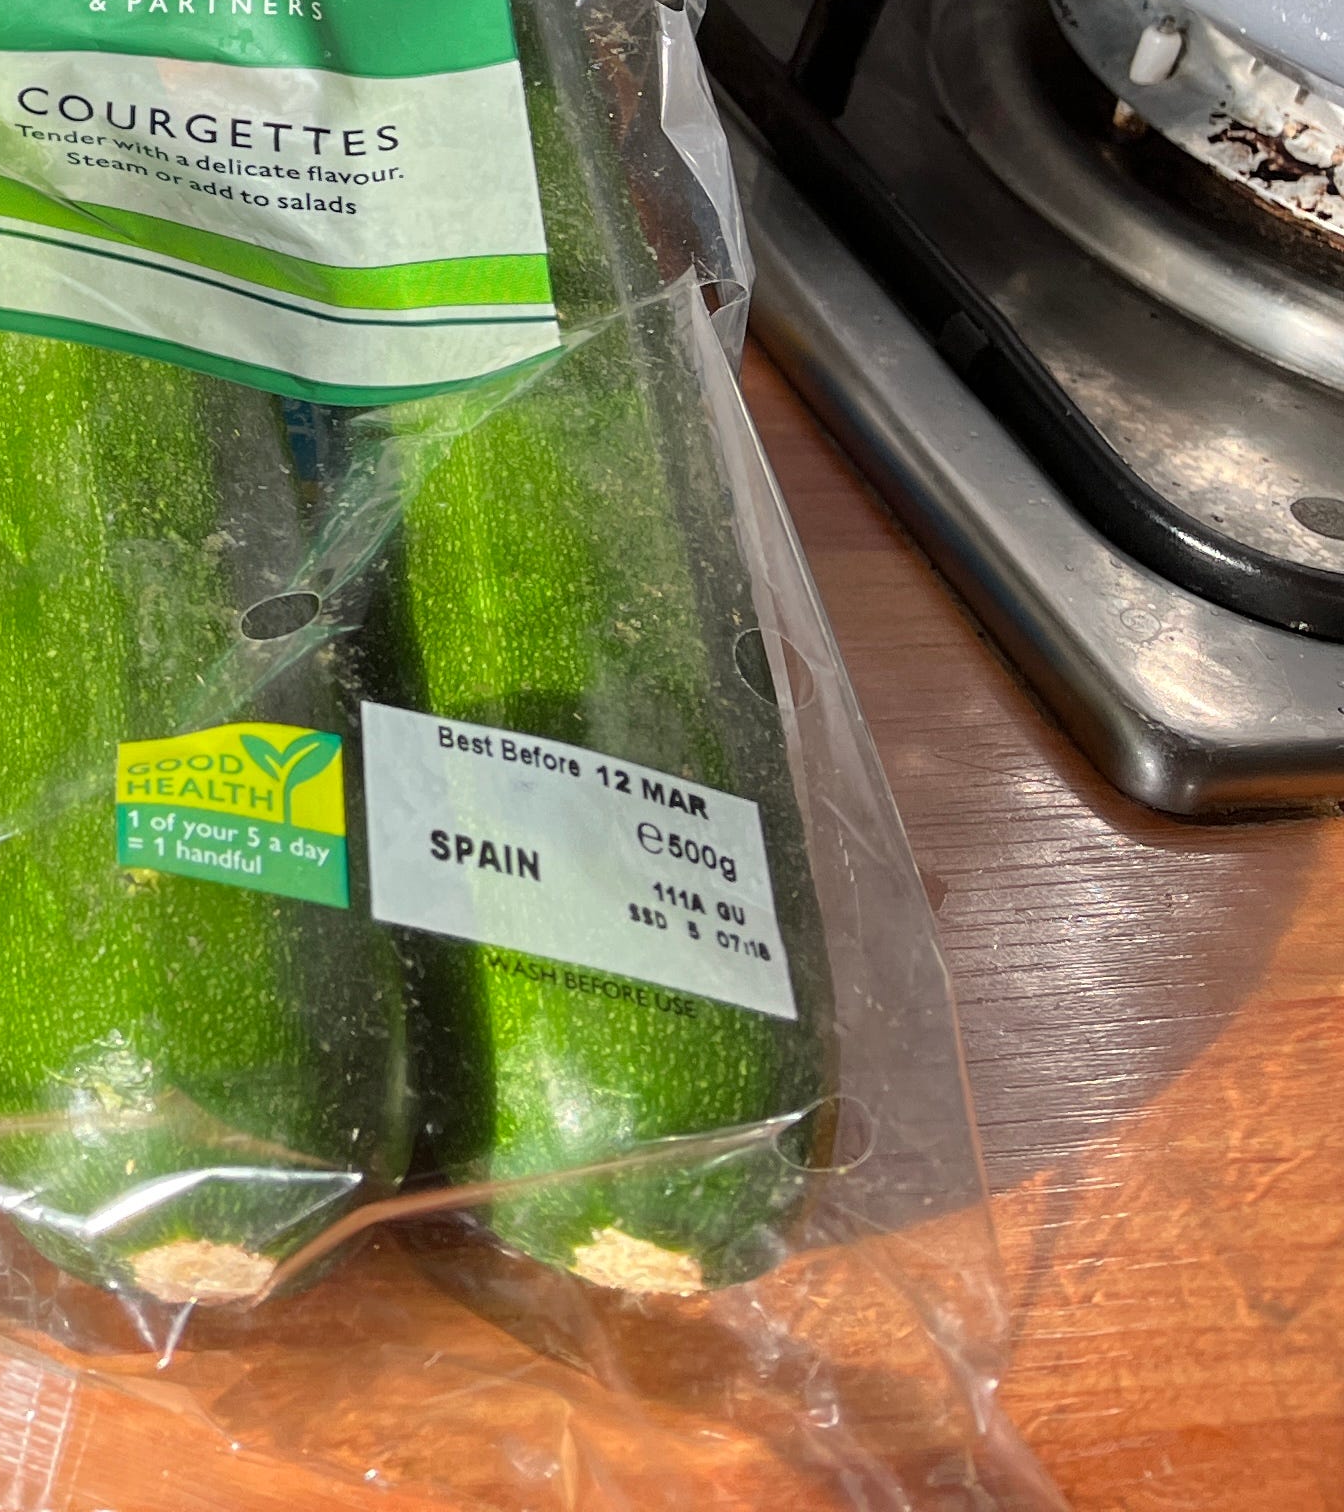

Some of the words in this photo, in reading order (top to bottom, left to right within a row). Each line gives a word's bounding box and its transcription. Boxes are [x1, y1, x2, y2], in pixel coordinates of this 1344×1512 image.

[17, 87, 401, 157] COURGETTES
[15, 123, 110, 148] Tender
[113, 137, 169, 163] with
[176, 152, 190, 167] a
[196, 154, 302, 182] delicate
[306, 164, 406, 187] flavour.
[66, 151, 149, 177] Steam
[156, 168, 183, 186] or
[189, 178, 234, 202] add
[241, 189, 270, 209] to
[277, 192, 358, 217] salads
[127, 754, 244, 776] GOOD
[437, 725, 494, 758] Best
[501, 738, 582, 778] Before
[596, 764, 632, 795] 12
[641, 778, 710, 821] MAR
[127, 777, 274, 812] HEALTH
[128, 809, 139, 829] 1
[150, 813, 177, 832] of
[182, 819, 239, 843] your
[247, 826, 261, 848] 5
[268, 837, 283, 853] a
[289, 837, 330, 867] day
[153, 837, 165, 857] 1
[175, 840, 262, 876] handful
[430, 829, 542, 882] SPAIN
[668, 832, 737, 883] 500g
[653, 881, 707, 916] 111A
[488, 955, 558, 985] WASH
[564, 971, 649, 1008] BEFORE
[655, 991, 698, 1019] USE
